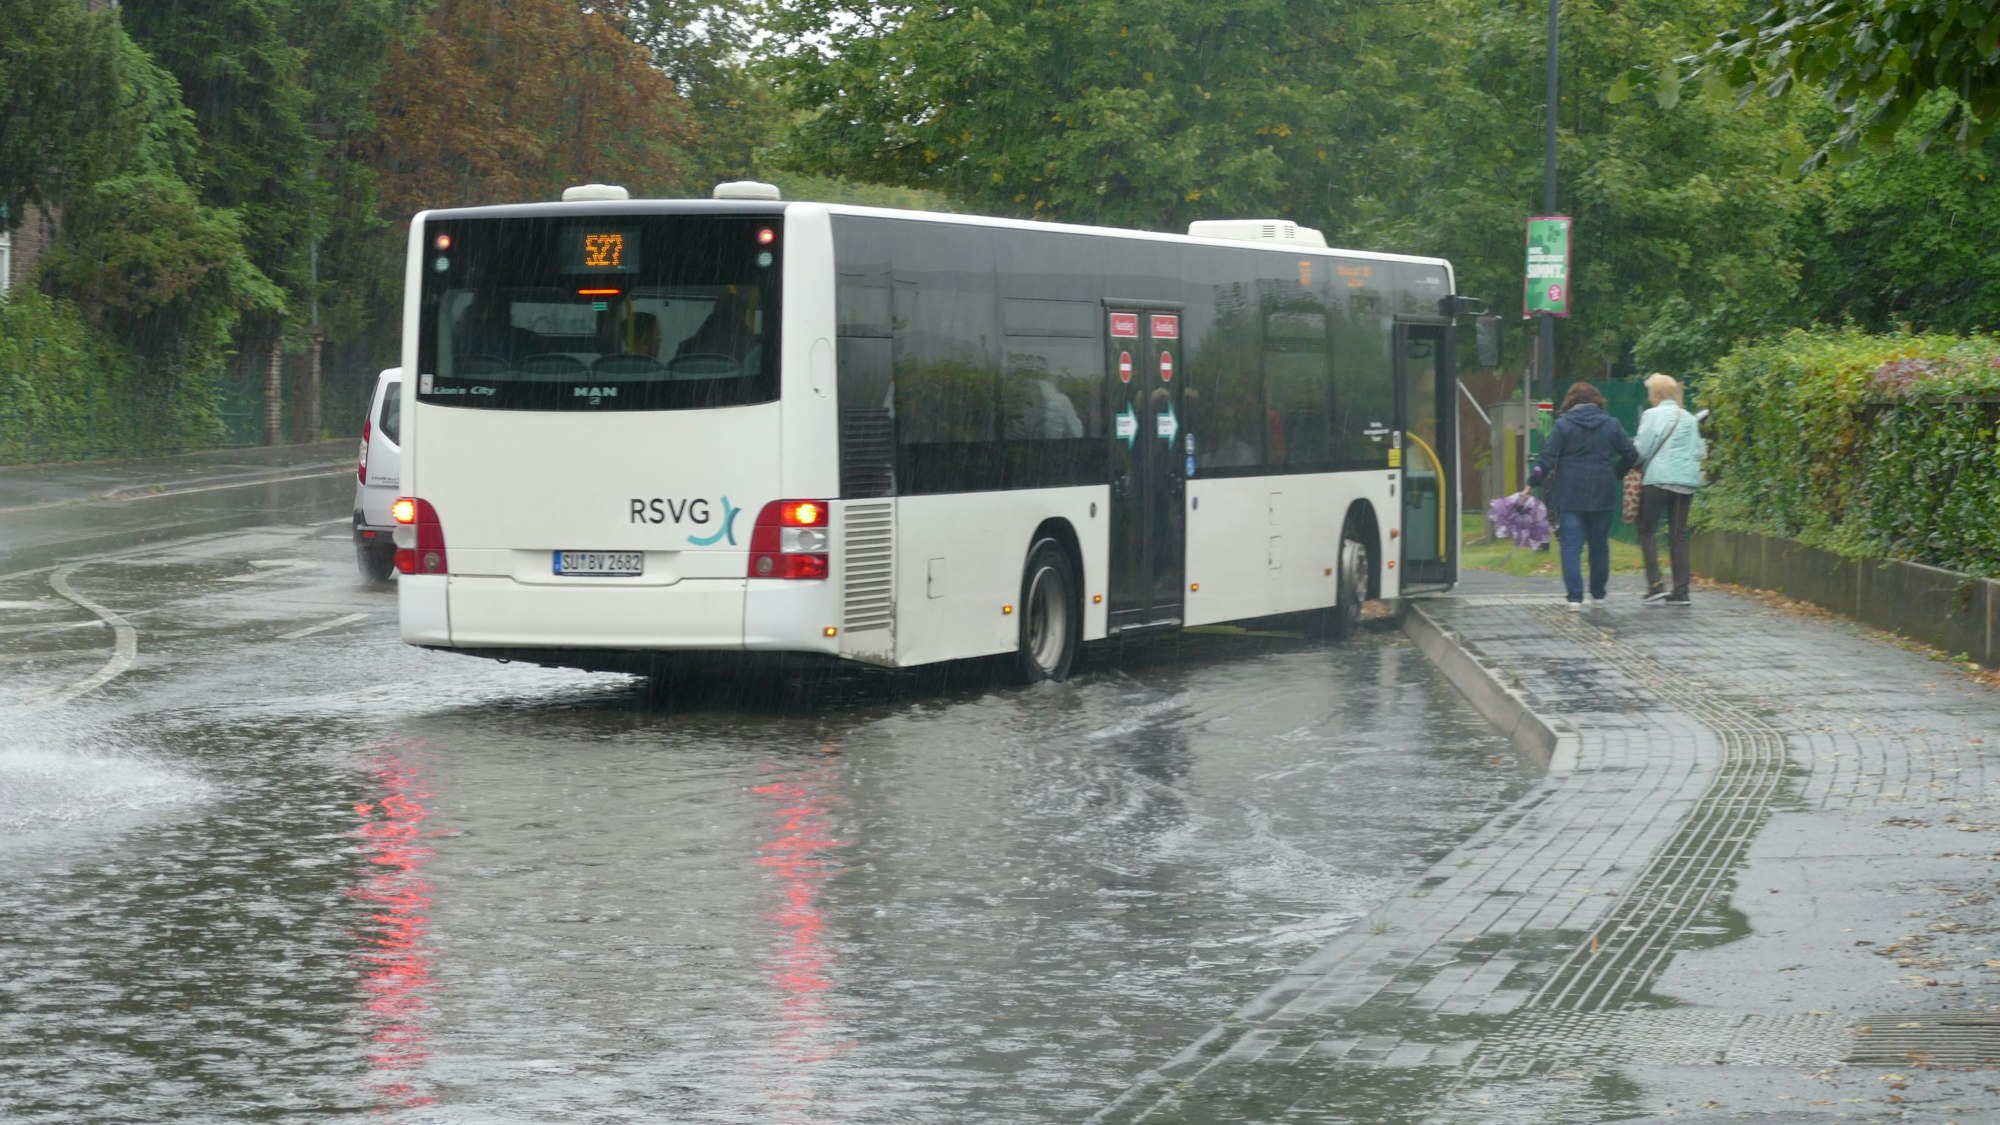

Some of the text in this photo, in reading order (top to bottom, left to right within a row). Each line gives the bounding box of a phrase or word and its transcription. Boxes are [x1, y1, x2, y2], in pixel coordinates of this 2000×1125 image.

[585, 234, 622, 266] 527
[433, 385, 497, 396] Lion's City
[574, 387, 617, 397] MAN
[630, 498, 710, 524] RSVG
[562, 554, 641, 570] SU BV 2682
